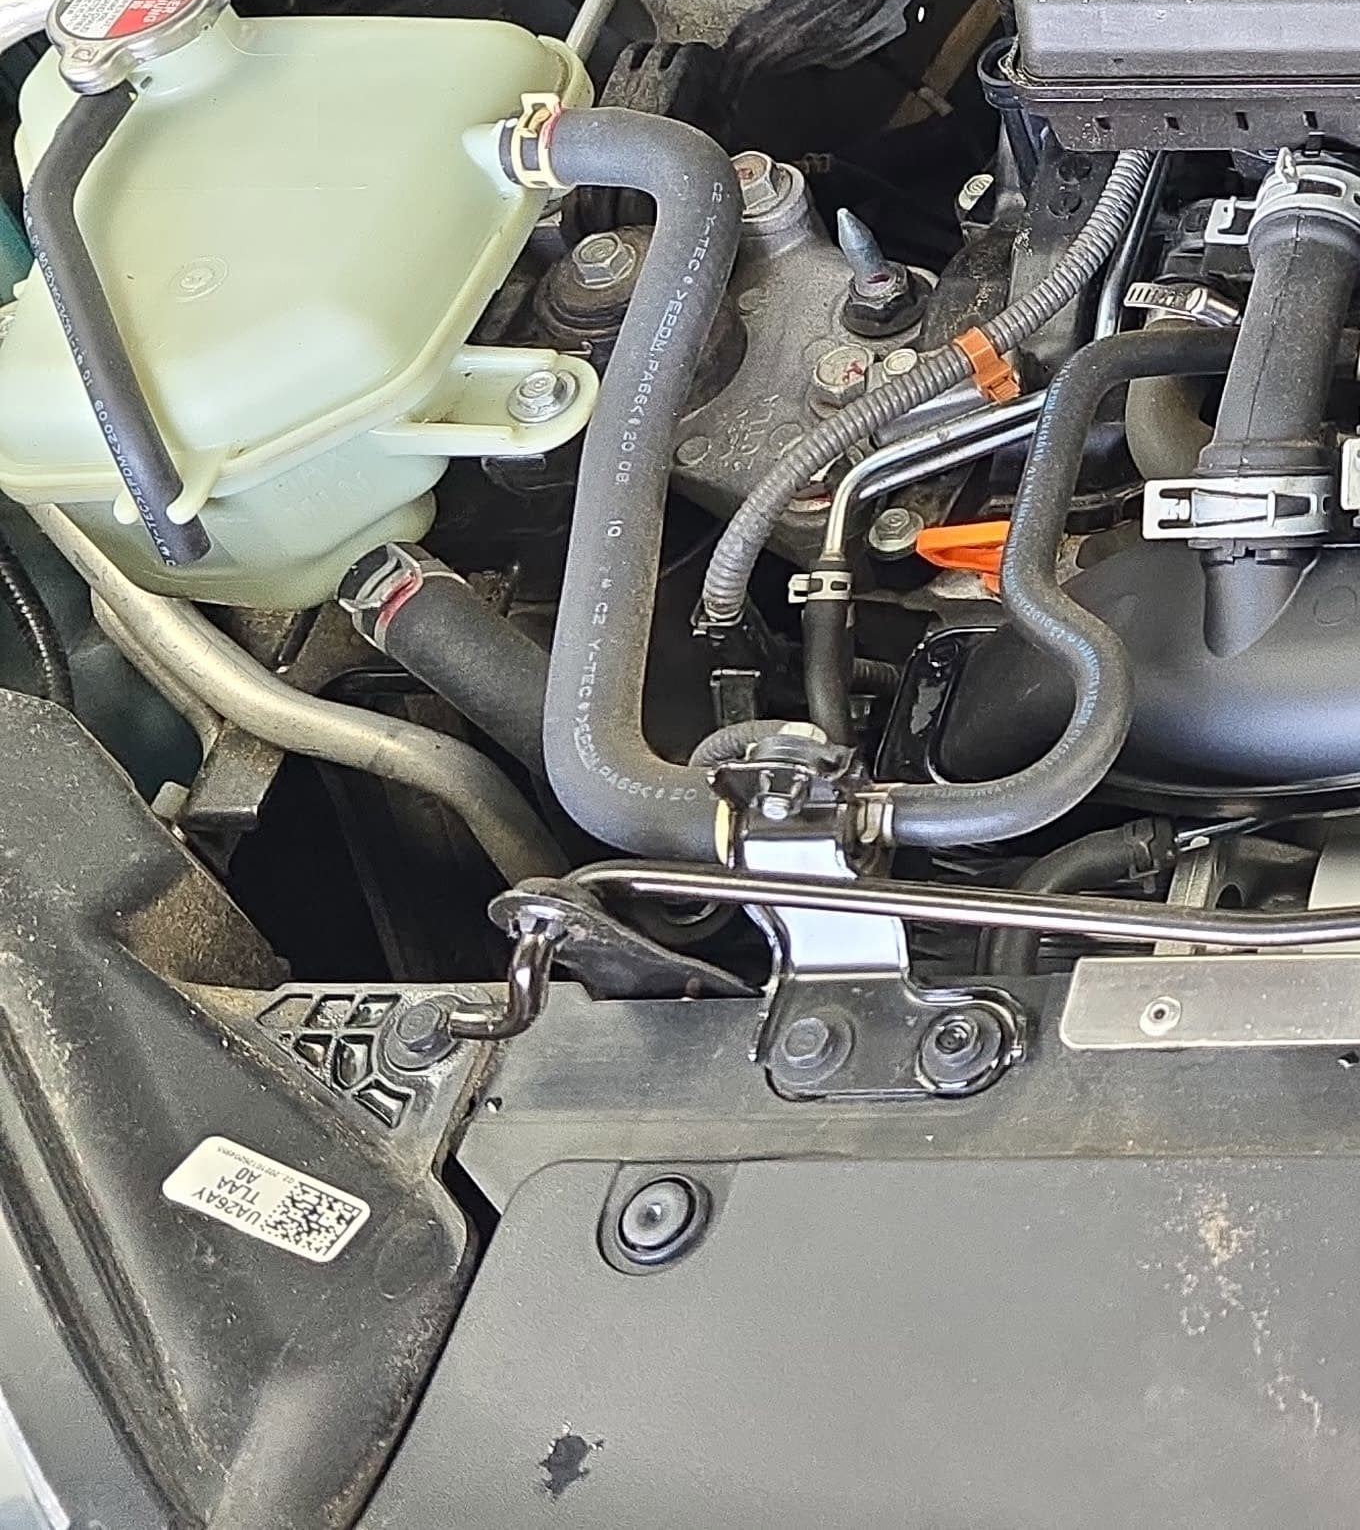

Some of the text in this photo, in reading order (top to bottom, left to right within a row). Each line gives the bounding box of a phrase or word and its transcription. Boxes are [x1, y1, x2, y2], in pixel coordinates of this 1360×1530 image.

[688, 212, 720, 271] Y-TEC
[191, 1187, 262, 1226] UA26AY
[216, 1176, 260, 1205] TLAA
